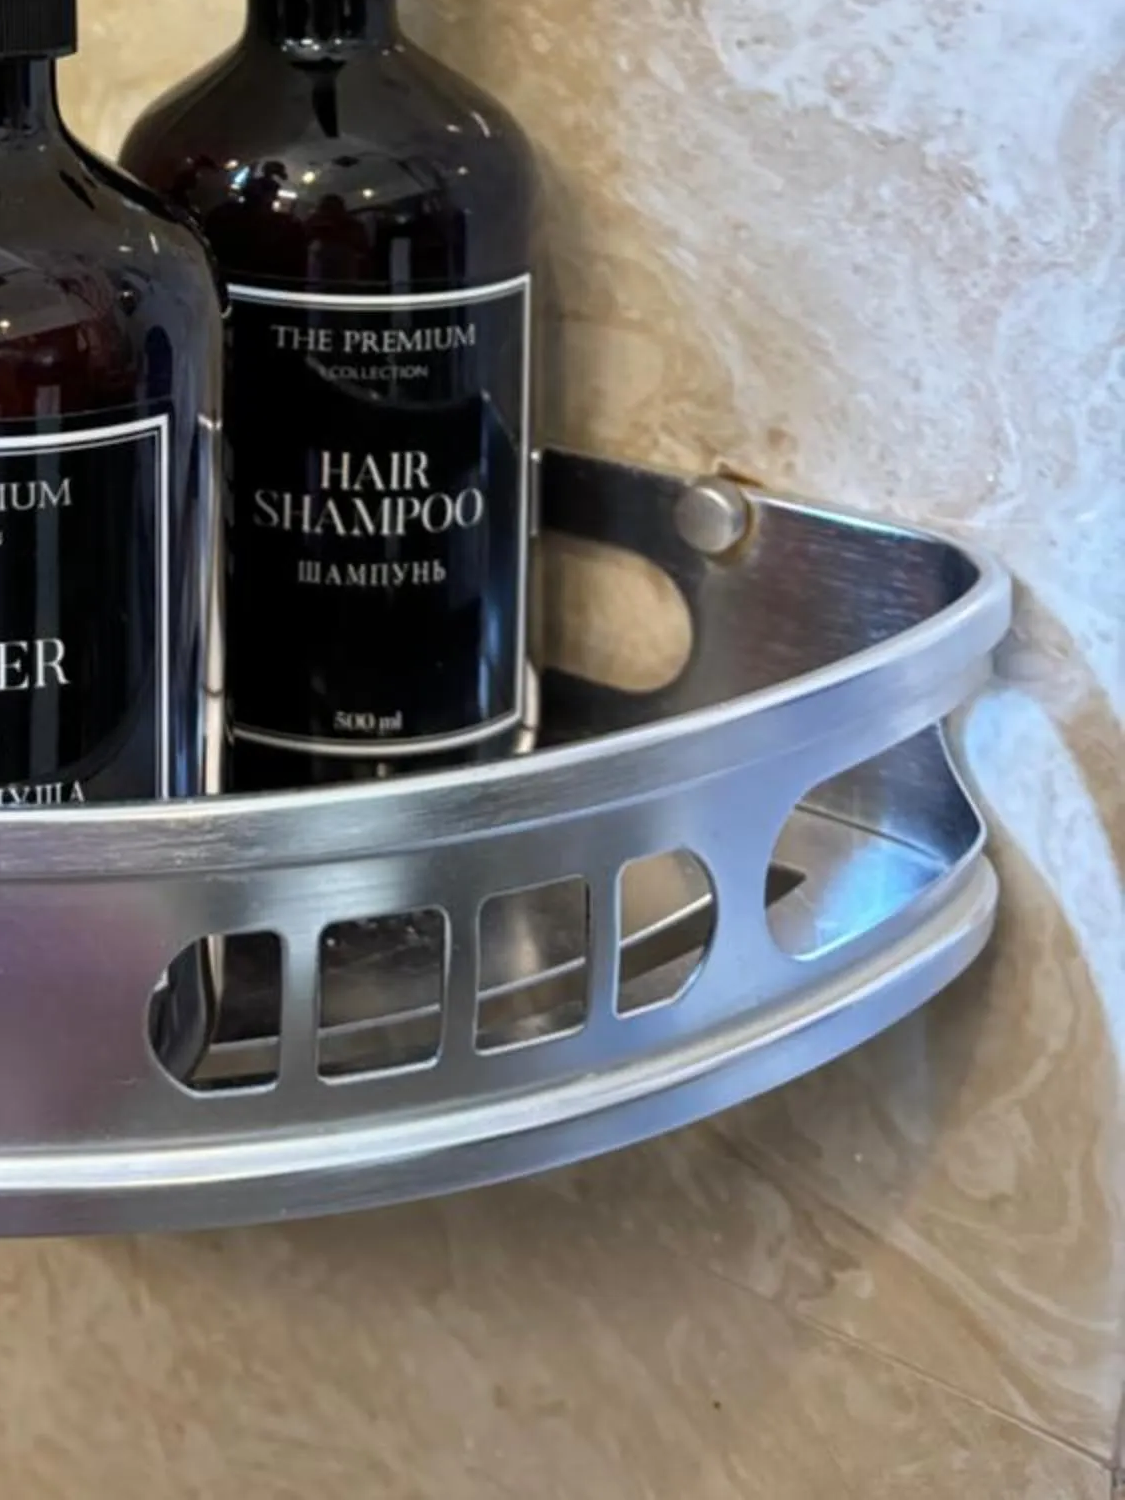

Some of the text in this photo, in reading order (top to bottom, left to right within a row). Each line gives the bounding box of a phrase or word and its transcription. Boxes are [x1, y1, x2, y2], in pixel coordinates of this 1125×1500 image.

[271, 323, 477, 354] THE PREMIUM
[327, 365, 429, 381] COLLECTION
[320, 450, 430, 492] HAIR
[253, 488, 484, 537] SHAMPOO
[297, 559, 447, 587] ШАМПУНЬ
[334, 711, 375, 732] 500
